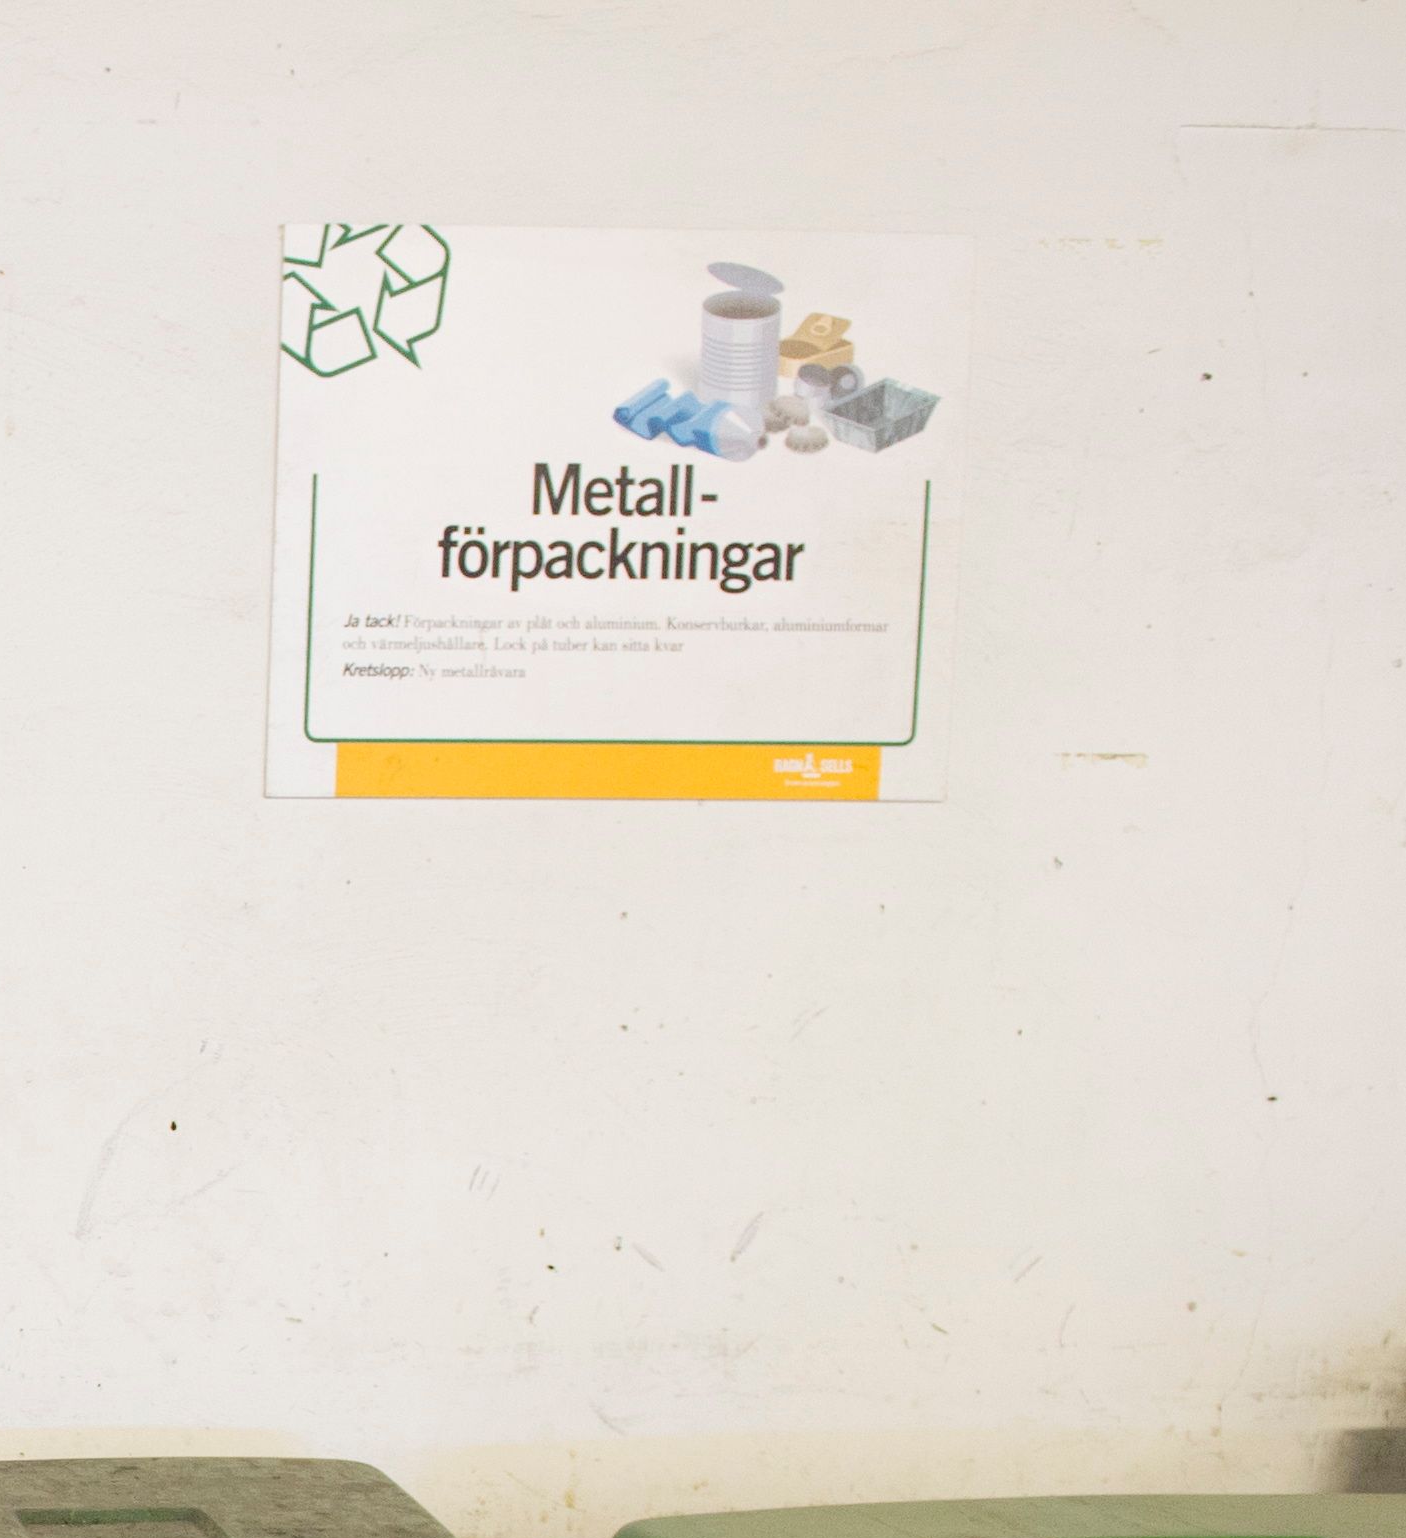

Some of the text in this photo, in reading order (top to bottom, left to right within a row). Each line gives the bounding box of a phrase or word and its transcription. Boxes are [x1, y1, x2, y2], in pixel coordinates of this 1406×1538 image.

[532, 463, 719, 517] Metall-
[437, 525, 805, 594] förpackningar
[344, 614, 360, 628] Ja
[365, 613, 401, 628] tack!
[404, 615, 503, 632] Förpackningar
[507, 618, 522, 629] av
[527, 615, 553, 632] plåt
[556, 615, 581, 630] och
[342, 637, 367, 651] och
[494, 637, 526, 651] Lock
[531, 638, 549, 655] på
[552, 638, 589, 652] tuber
[592, 638, 618, 652] kan
[621, 638, 650, 652] sitta
[654, 638, 684, 652] kvar
[342, 663, 527, 680] Kretslopp: Ny metallråvara
